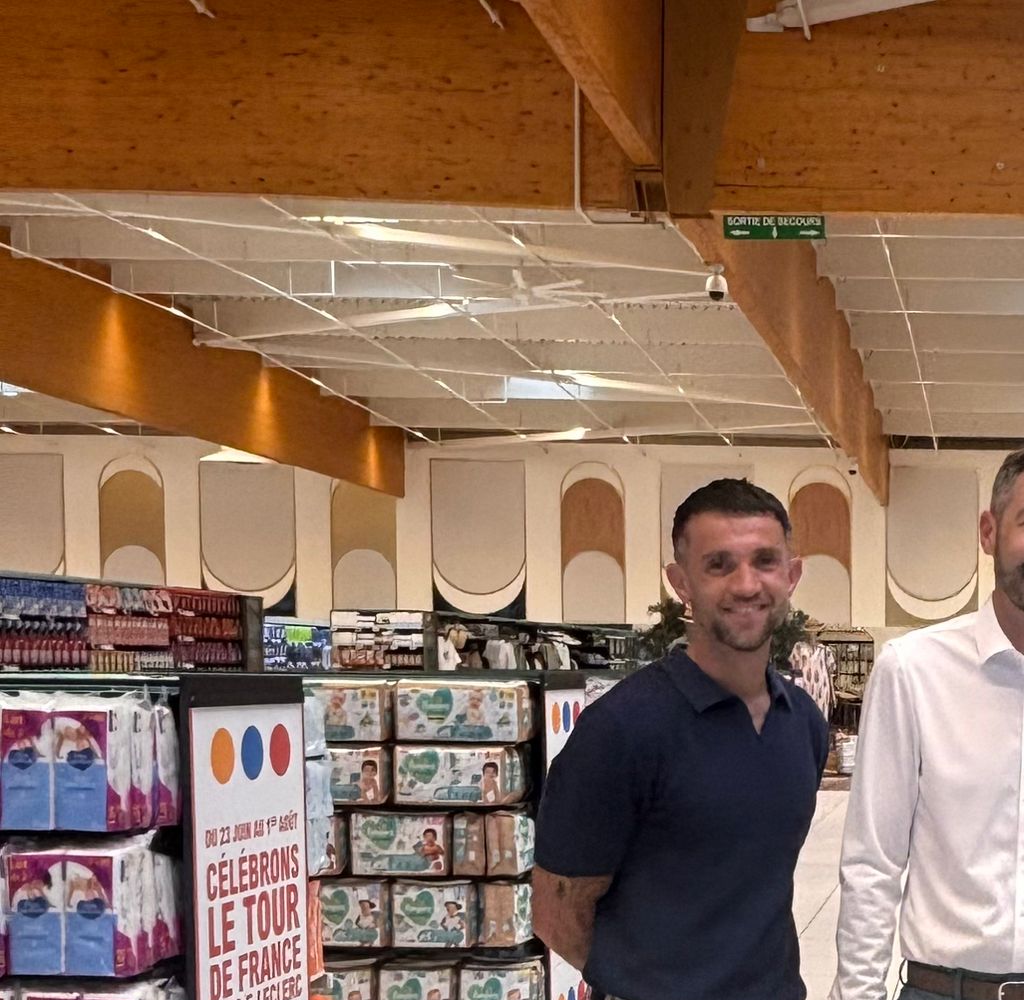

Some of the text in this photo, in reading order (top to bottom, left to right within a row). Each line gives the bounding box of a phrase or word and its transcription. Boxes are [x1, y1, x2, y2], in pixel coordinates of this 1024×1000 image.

[763, 216, 776, 226] DE
[220, 826, 231, 846] 23
[206, 843, 299, 901] CÉLÉBRONS
[208, 883, 301, 959] LE TOUR
[238, 934, 302, 992] FRANCE
